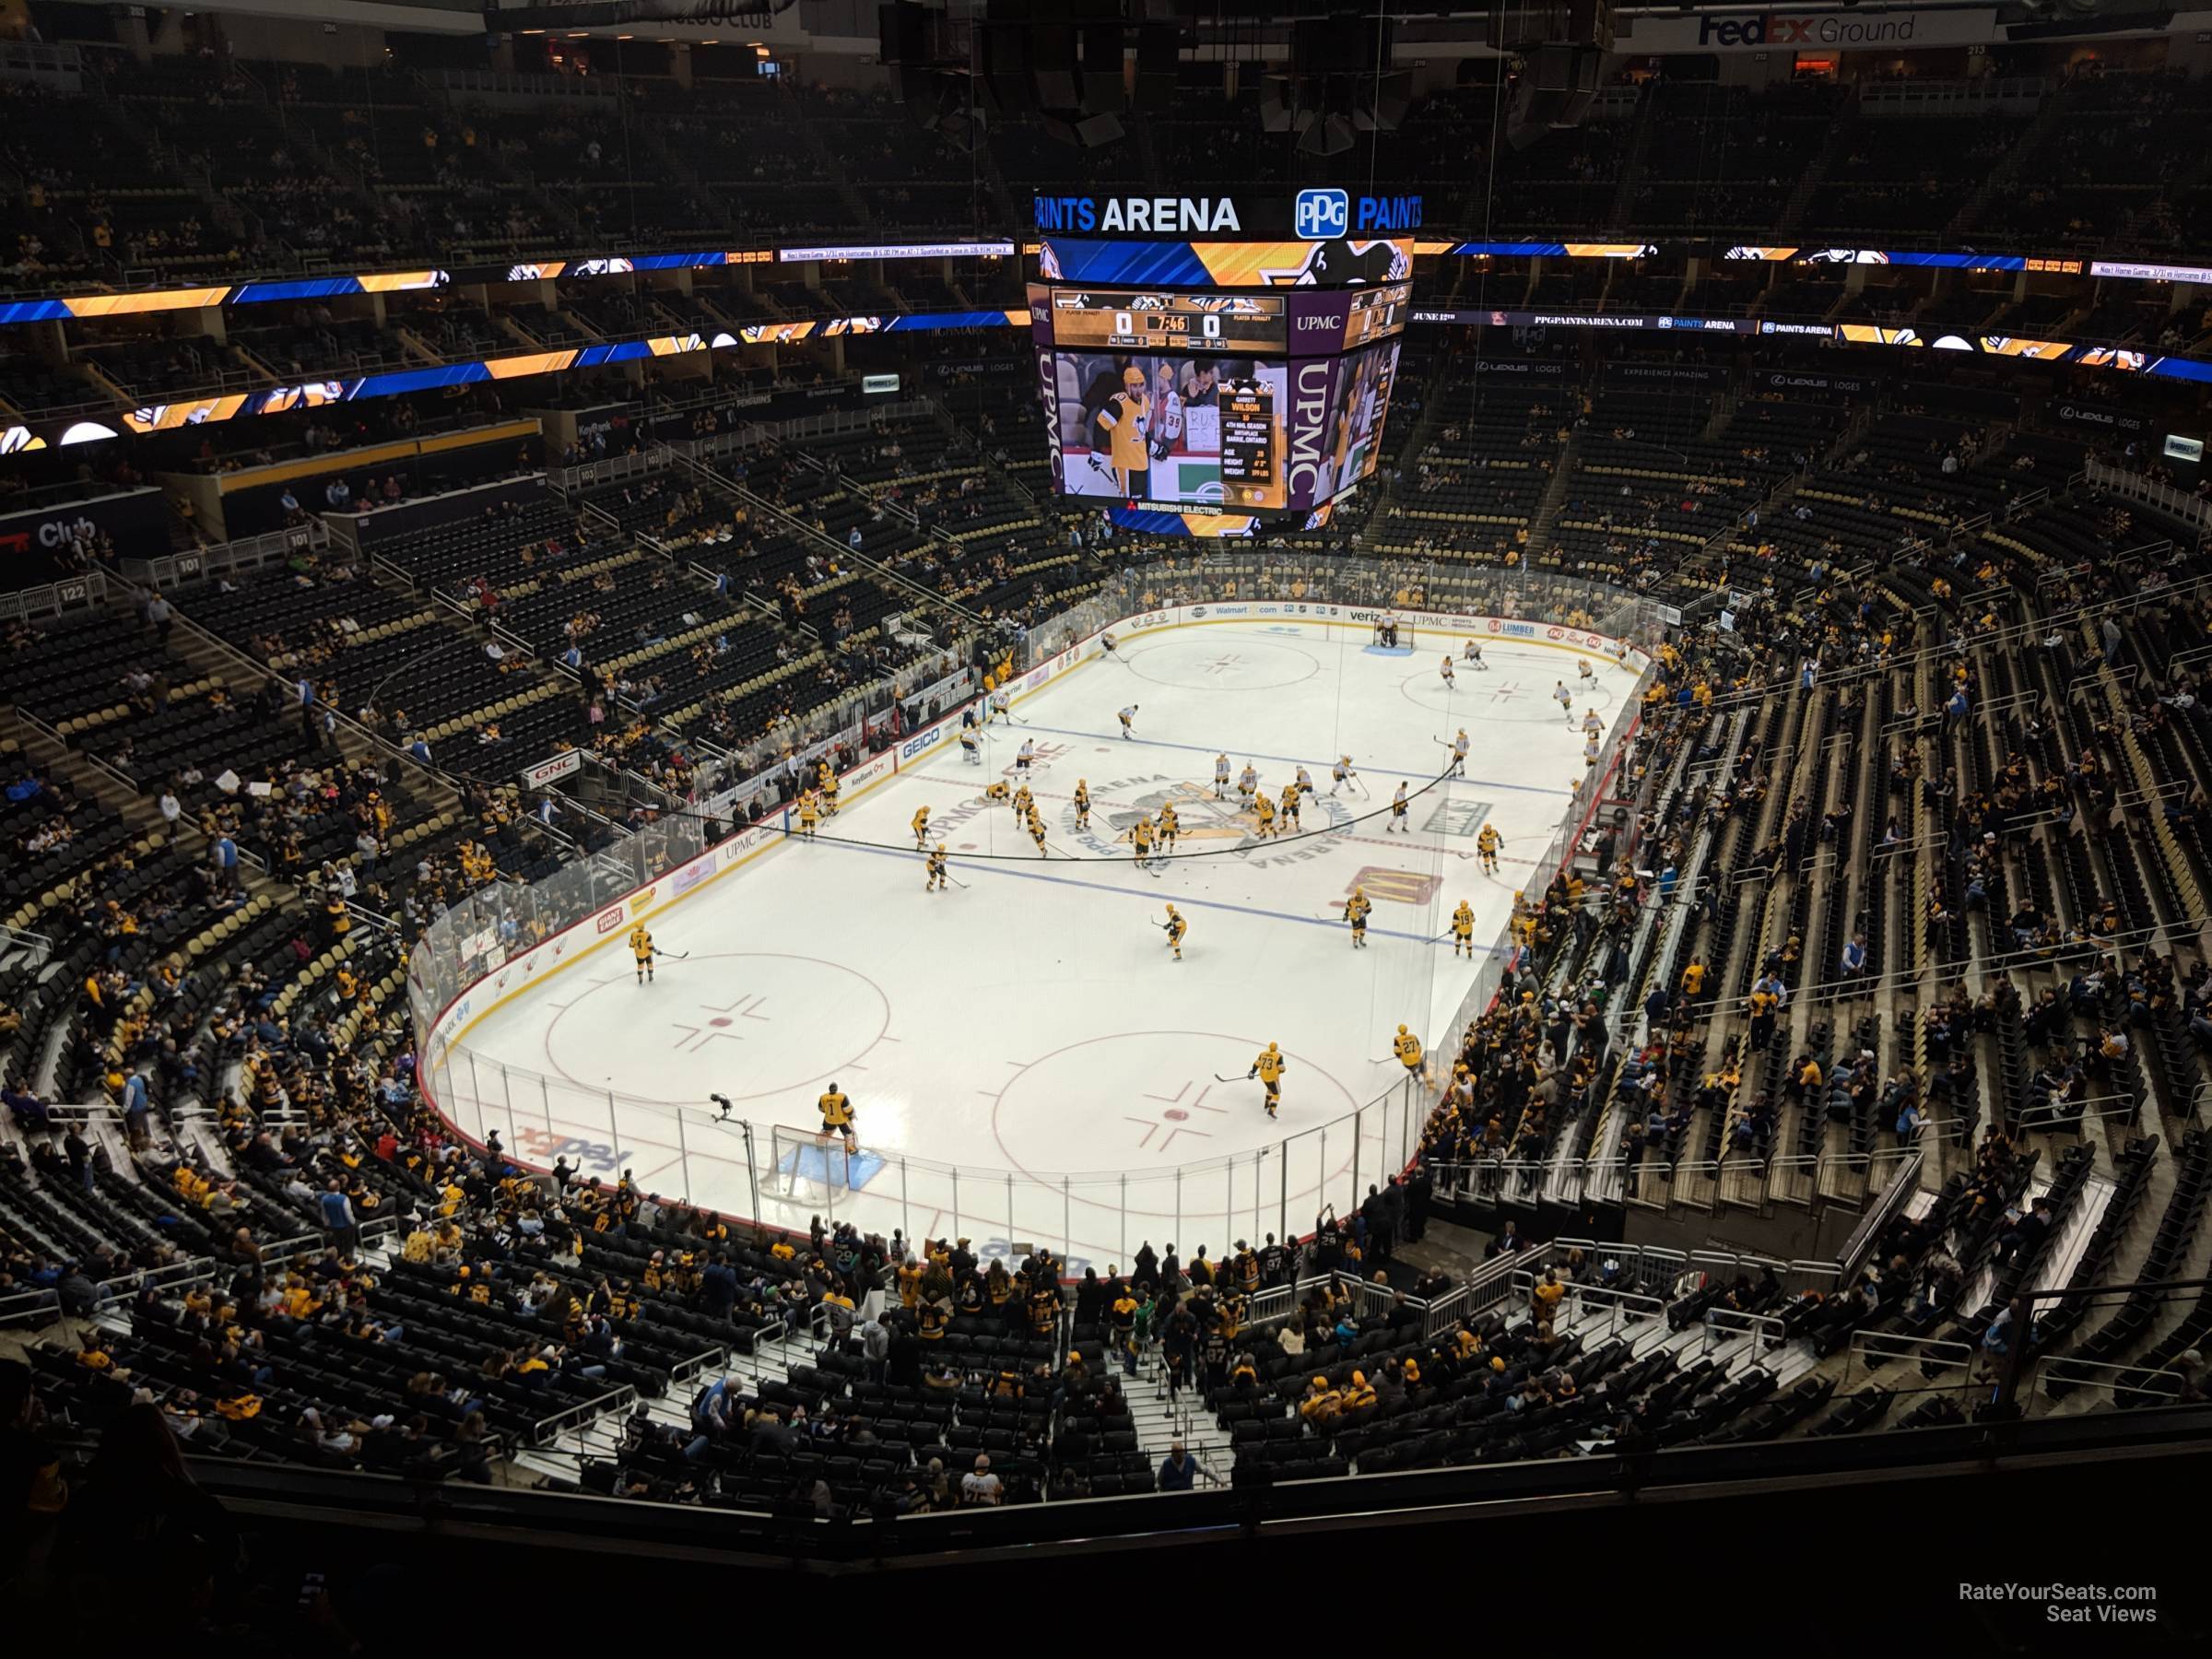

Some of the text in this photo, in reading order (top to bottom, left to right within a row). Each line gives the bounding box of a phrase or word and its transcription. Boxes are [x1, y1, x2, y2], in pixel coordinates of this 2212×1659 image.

[729, 14, 772, 29] CLUB
[1699, 14, 1915, 46] FedEx Ground
[1968, 45, 1986, 55] 213
[1101, 197, 1241, 232] ARENA
[1300, 194, 1345, 233] PPG
[1358, 195, 1422, 230] PAINTS
[1031, 306, 1050, 323] UPMC
[1364, 310, 1371, 331] 0
[1386, 303, 1394, 325] 0
[1116, 312, 1132, 334] 0
[1158, 316, 1184, 331] 7:46
[1203, 314, 1220, 337] 0
[1297, 315, 1341, 330] UPMC
[1535, 316, 1642, 327] PPGPAINTSARENA.COM
[1674, 320, 1703, 328] PAINTS
[1704, 321, 1735, 330] ARENA
[1805, 326, 1831, 335] ARENA
[1535, 365, 1561, 373] LOGES
[1674, 371, 1709, 379] AMAZING
[1787, 378, 1860, 391] LEXUS LOGES
[737, 394, 772, 407] PENGUINS
[1231, 403, 1261, 412] WILSON
[1039, 353, 1064, 479] UPMC
[1168, 416, 1180, 428] 39
[2076, 411, 2141, 429] LEXUS LOGES
[1288, 360, 1329, 495] UPMC
[1137, 502, 1223, 515] MITSUBISHI ELECTRIC
[39, 516, 97, 547] Club
[291, 534, 308, 547] 101
[181, 559, 200, 573] 101
[62, 585, 86, 602] 122
[1216, 606, 1247, 615] Walmart
[1413, 615, 1447, 627] UPMC
[1502, 623, 1535, 635] LUMBER
[903, 728, 939, 759] GEICO
[535, 757, 574, 779] GNC
[852, 769, 873, 788] KeyBank
[726, 832, 757, 859] UPMC
[1077, 834, 1121, 856] PPG
[1249, 837, 1342, 869] ARENA
[1460, 914, 1470, 926] 19
[637, 939, 642, 949] 4
[1403, 1041, 1416, 1054] 27
[1261, 1057, 1274, 1071] 73
[829, 1102, 834, 1116] 1
[509, 1125, 634, 1171] FedEx
[1321, 1236, 1336, 1246] 29
[836, 1249, 852, 1262] 29
[905, 1278, 913, 1291] 7
